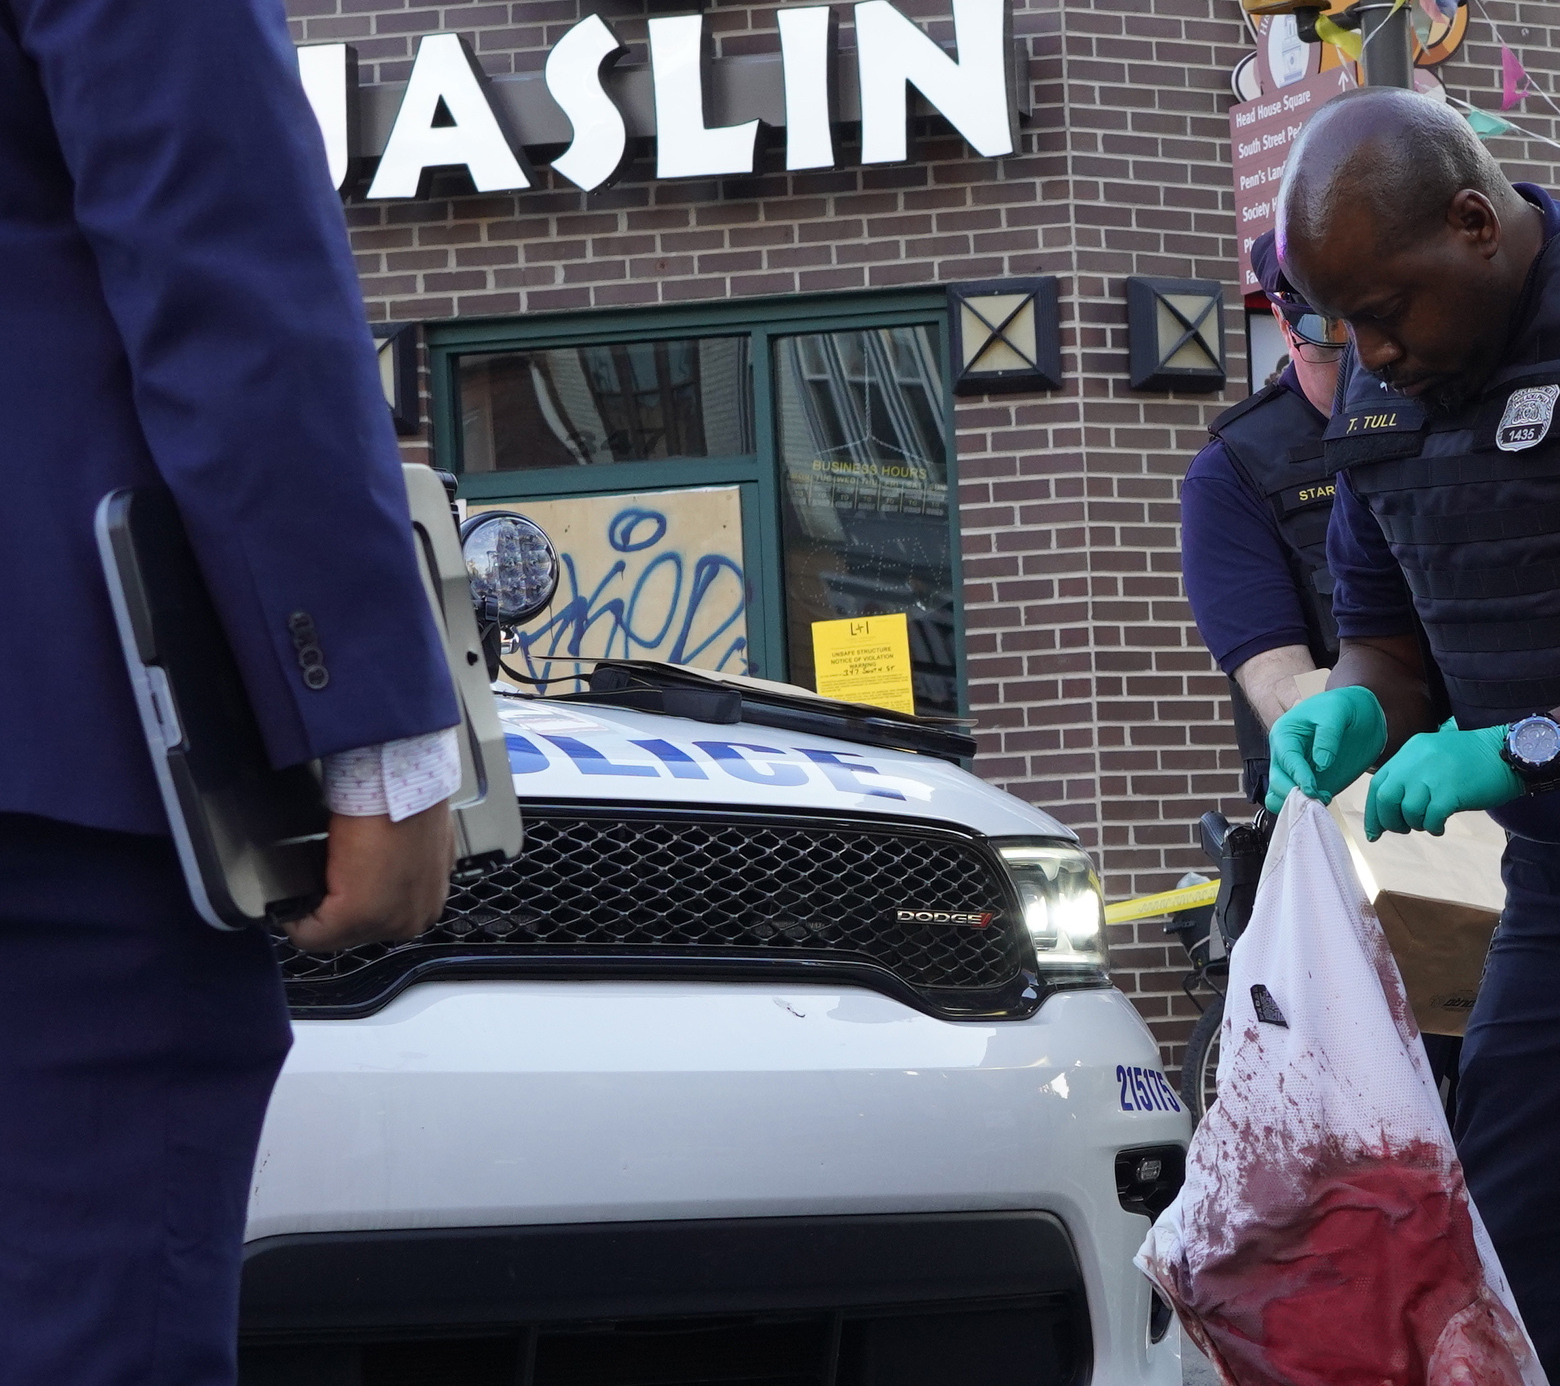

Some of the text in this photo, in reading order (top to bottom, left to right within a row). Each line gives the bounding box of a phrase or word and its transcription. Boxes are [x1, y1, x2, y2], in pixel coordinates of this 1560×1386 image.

[1236, 90, 1311, 128] Head House Square
[1238, 141, 1262, 159] South
[1262, 133, 1287, 149] Street
[1240, 170, 1266, 191] Penn's
[1242, 201, 1270, 223] Society
[1363, 414, 1397, 429] TULL
[1509, 428, 1535, 442] 1435
[812, 460, 927, 479] BUSINESS HOURS
[1299, 484, 1338, 501] STAR
[831, 657, 852, 665] NOTICE
[863, 654, 893, 662] VIOLATION
[857, 646, 891, 656] STRUCTURE
[505, 733, 907, 802] OLICE
[897, 910, 983, 925] DODGE
[1116, 1065, 1181, 1113] 215175
